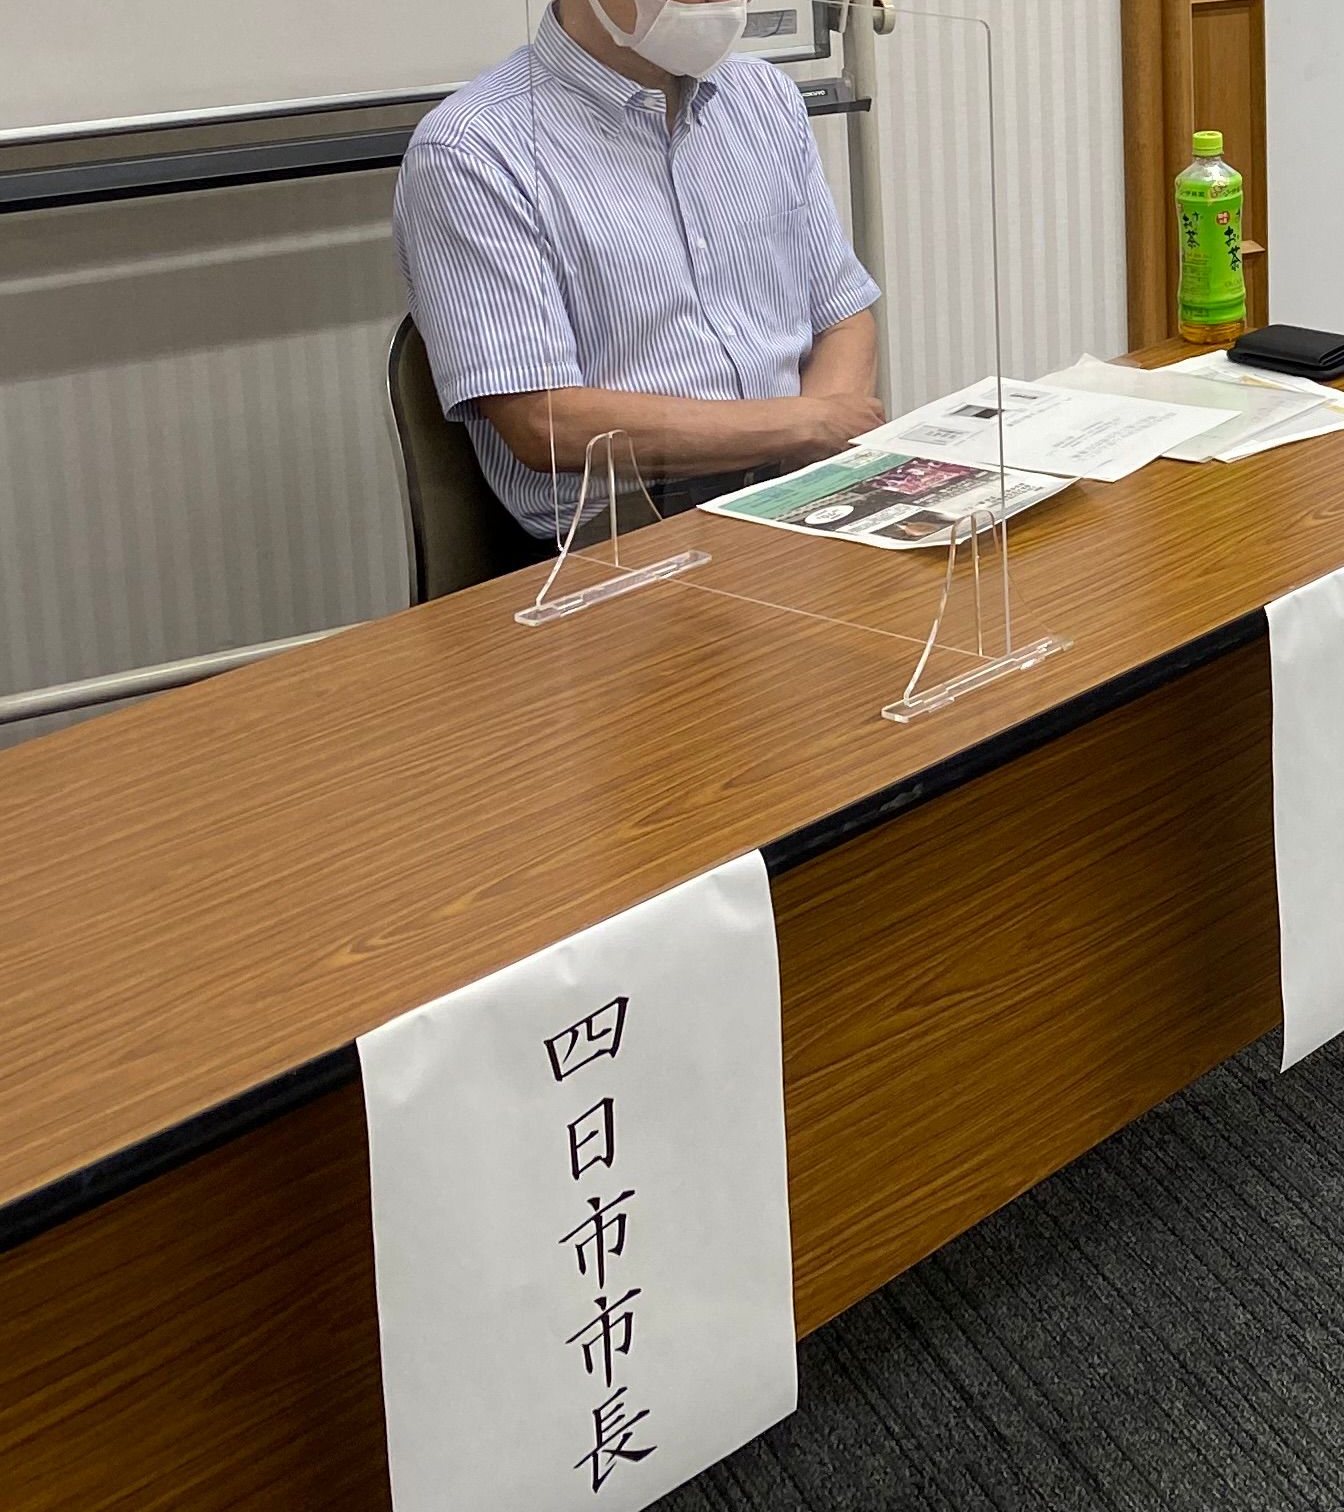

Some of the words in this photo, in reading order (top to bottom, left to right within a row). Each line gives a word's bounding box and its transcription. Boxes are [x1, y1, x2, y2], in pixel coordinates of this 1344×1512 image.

[543, 995, 658, 1494] 四日市市長
